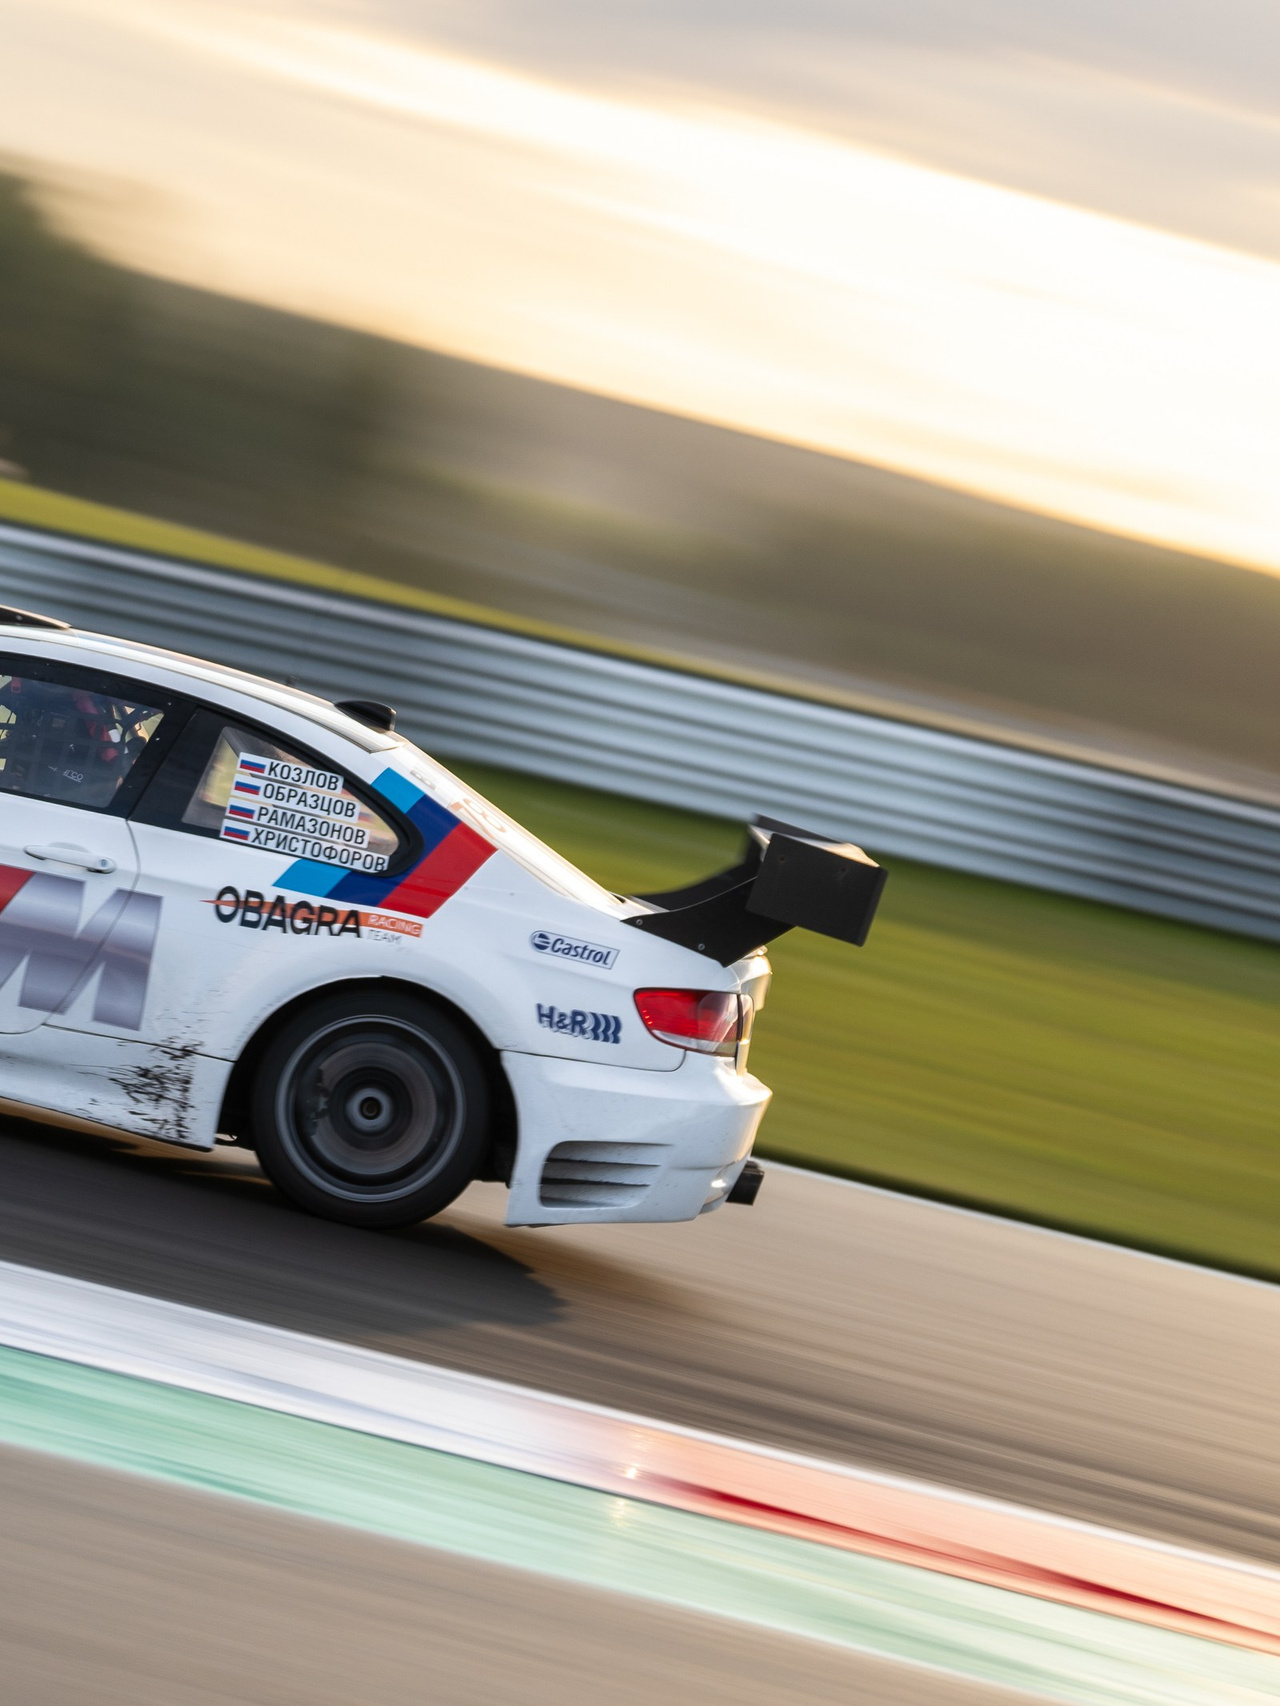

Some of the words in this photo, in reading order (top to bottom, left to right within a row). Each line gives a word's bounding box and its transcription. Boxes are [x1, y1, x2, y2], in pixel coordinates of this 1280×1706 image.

[267, 761, 340, 791] КОЗЛОВ
[262, 782, 357, 819] ОБРАЗЦОВ
[256, 806, 367, 845] РАМАЗОНОВ
[251, 828, 387, 872] ХРИСТОФОРОВ
[214, 885, 362, 939] OBAGRA
[368, 914, 421, 936] RACING
[551, 937, 612, 966] Castrol
